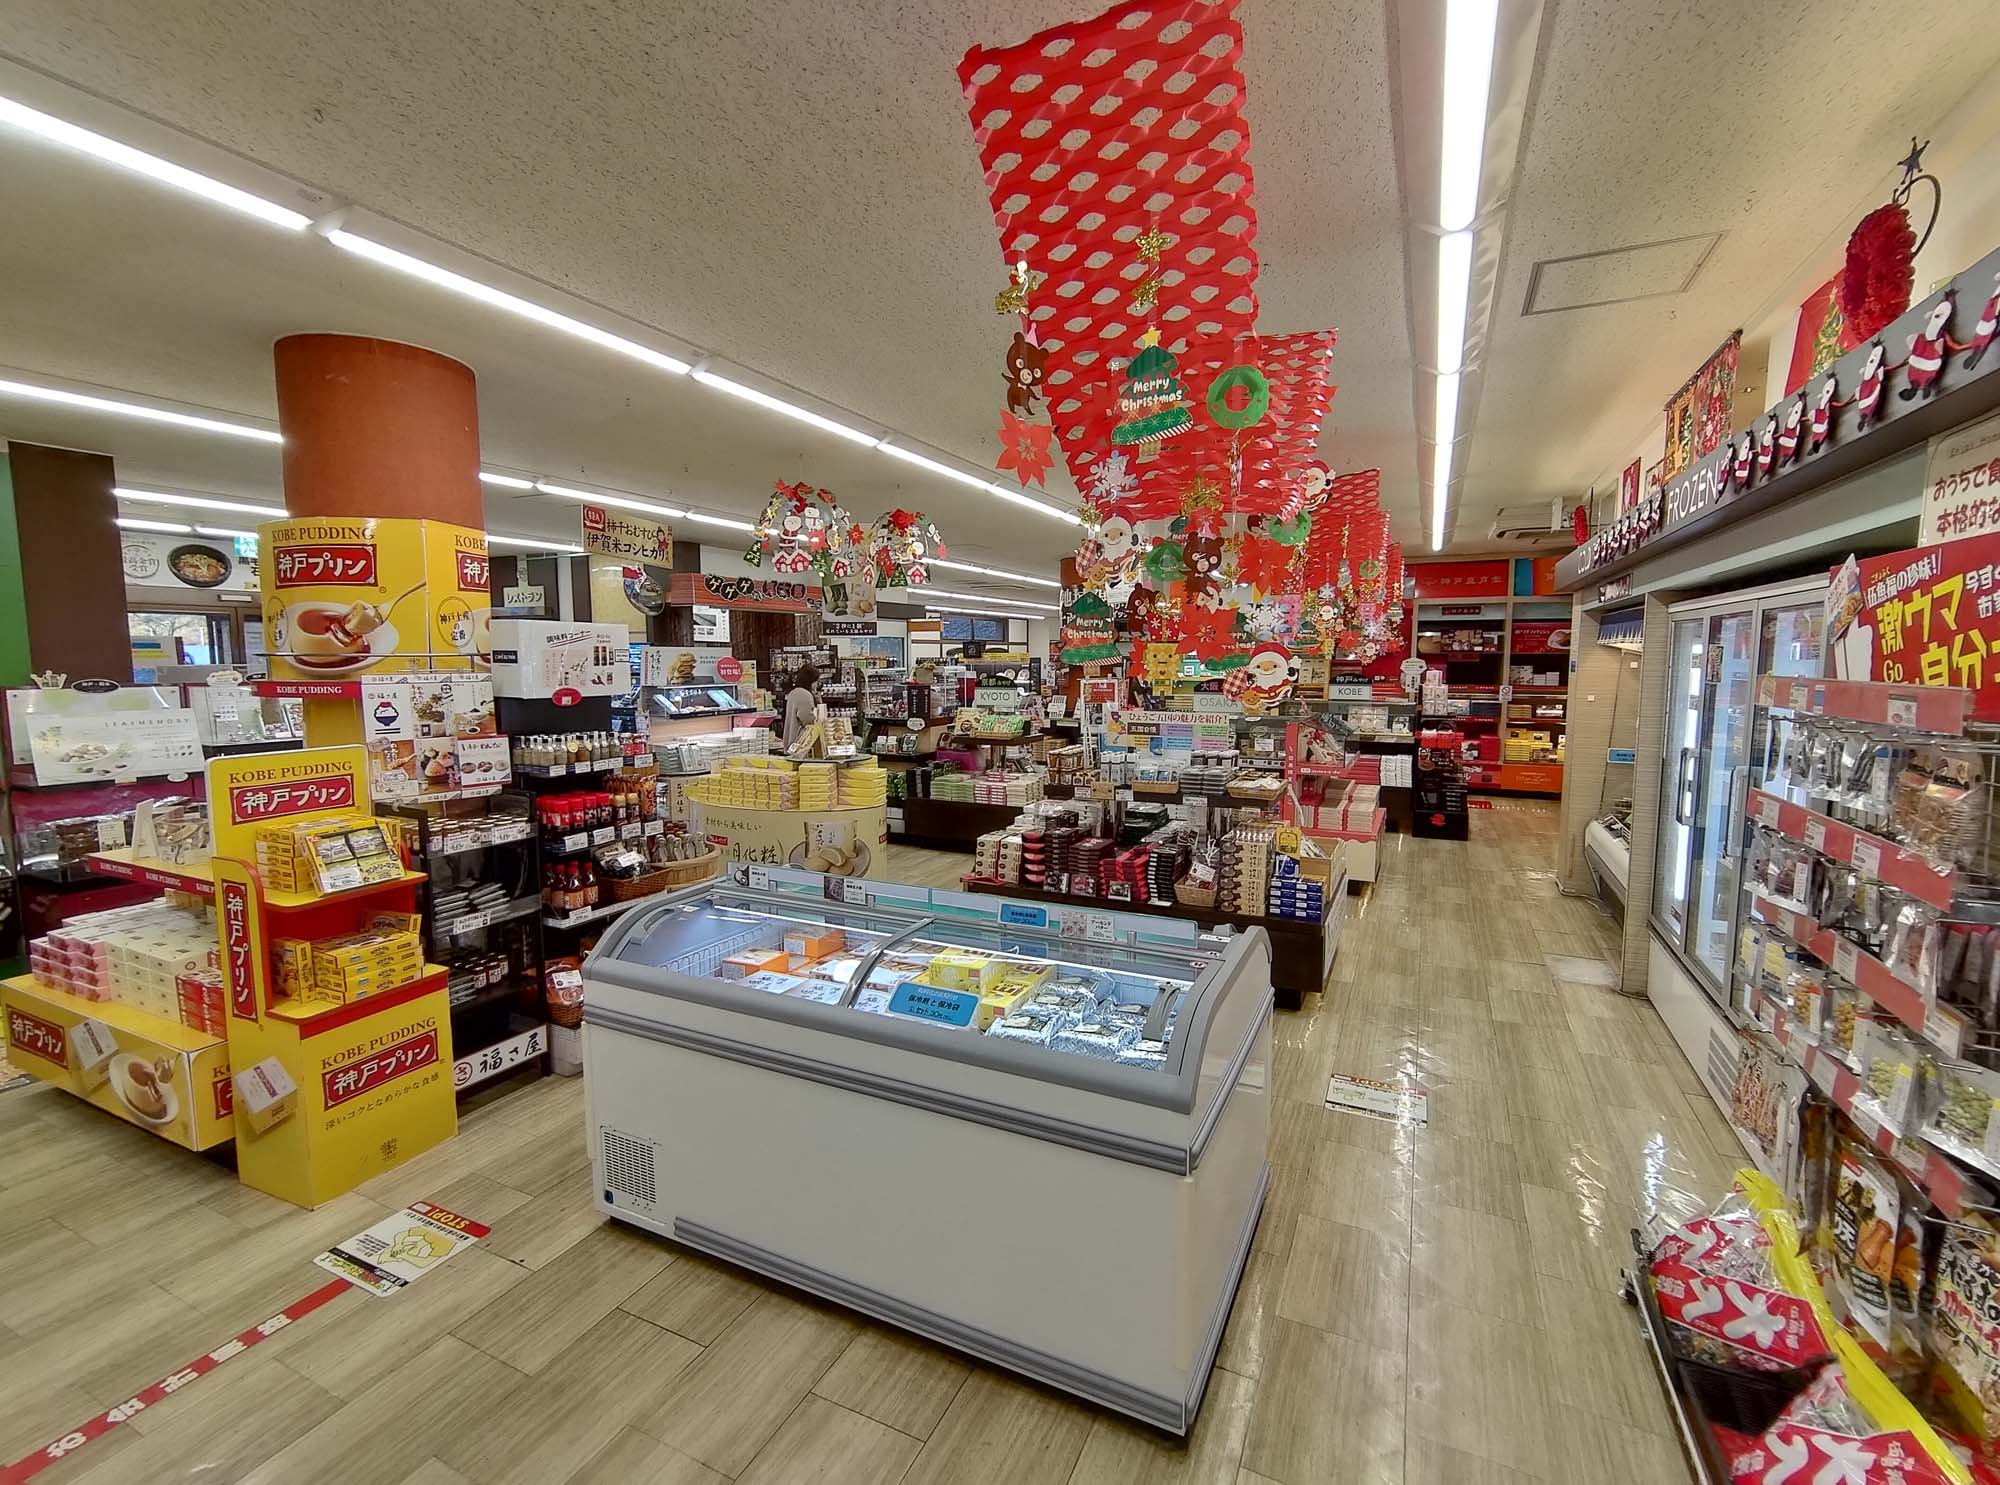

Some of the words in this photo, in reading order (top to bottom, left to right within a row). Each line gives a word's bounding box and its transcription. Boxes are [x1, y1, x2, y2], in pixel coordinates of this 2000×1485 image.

[1133, 377, 1170, 394] Merry
[1121, 390, 1184, 412] Christmas
[1667, 461, 1718, 525] FROZEN
[272, 528, 297, 543] KOBE
[299, 527, 375, 541] PUDDING
[455, 534, 486, 551] KOBE
[587, 532, 665, 561] 伊賀米コシヒカリ
[278, 553, 367, 578] 神戸プリン
[506, 592, 543, 604] レストラン
[1077, 617, 1104, 628] Merry
[1877, 574, 1964, 656] 激ウマ
[546, 630, 592, 644] 調味料コーナー
[1067, 628, 1113, 639] Christmas
[1335, 675, 1369, 684] 神戸みやげ
[1883, 659, 1904, 683] Go
[276, 686, 298, 695] KOBE
[299, 685, 343, 695] PUDDING
[980, 691, 1010, 701] KYOTO
[1338, 687, 1363, 696] KOBE
[1200, 697, 1239, 708] OSAKA
[229, 767, 277, 785] KOBE
[281, 761, 353, 779] PUDDING
[241, 785, 347, 815] 神戸プリン
[732, 842, 779, 865] 月化粧
[226, 893, 250, 1003] 神戸プリン
[11, 1014, 62, 1054] 神戸プリン
[321, 1043, 366, 1070] KOBE
[369, 1017, 437, 1051] PUDDING
[479, 1032, 543, 1073] 福さ屋
[333, 1043, 431, 1096] 神戸プリン
[324, 1073, 441, 1131] 深いコクとなめらかな食感
[429, 1208, 470, 1229] STOP!
